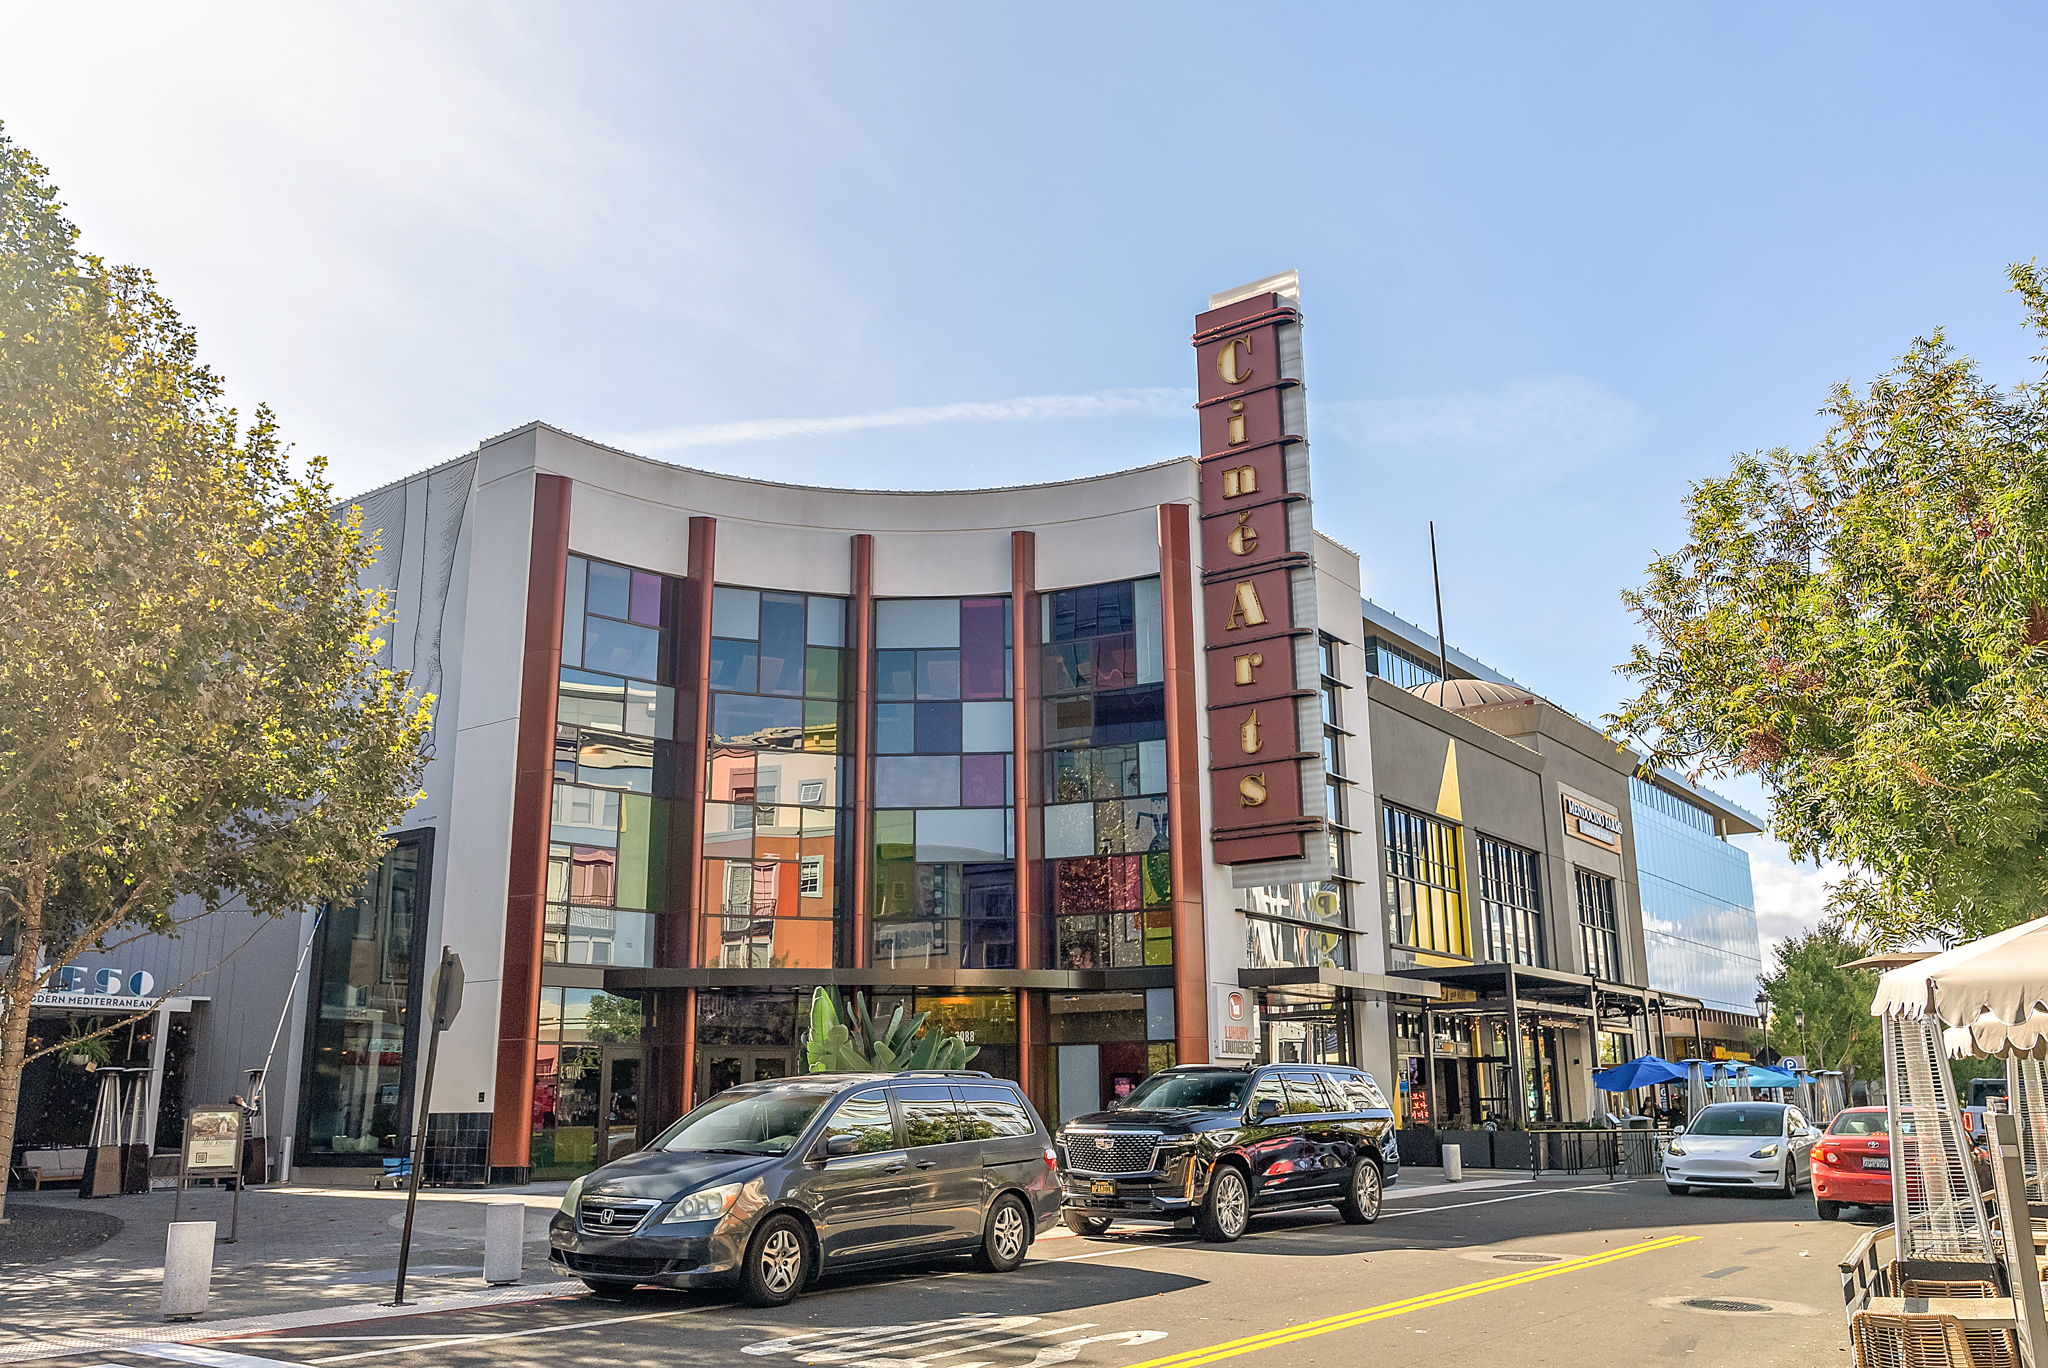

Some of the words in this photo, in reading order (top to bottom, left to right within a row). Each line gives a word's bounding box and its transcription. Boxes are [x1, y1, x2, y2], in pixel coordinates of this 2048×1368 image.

[35, 965, 154, 997] ESO
[68, 996, 152, 1008] MEDITERRANEAN
[1225, 1026, 1248, 1040] LUXURY
[1221, 1040, 1253, 1055] LOUNGERS
